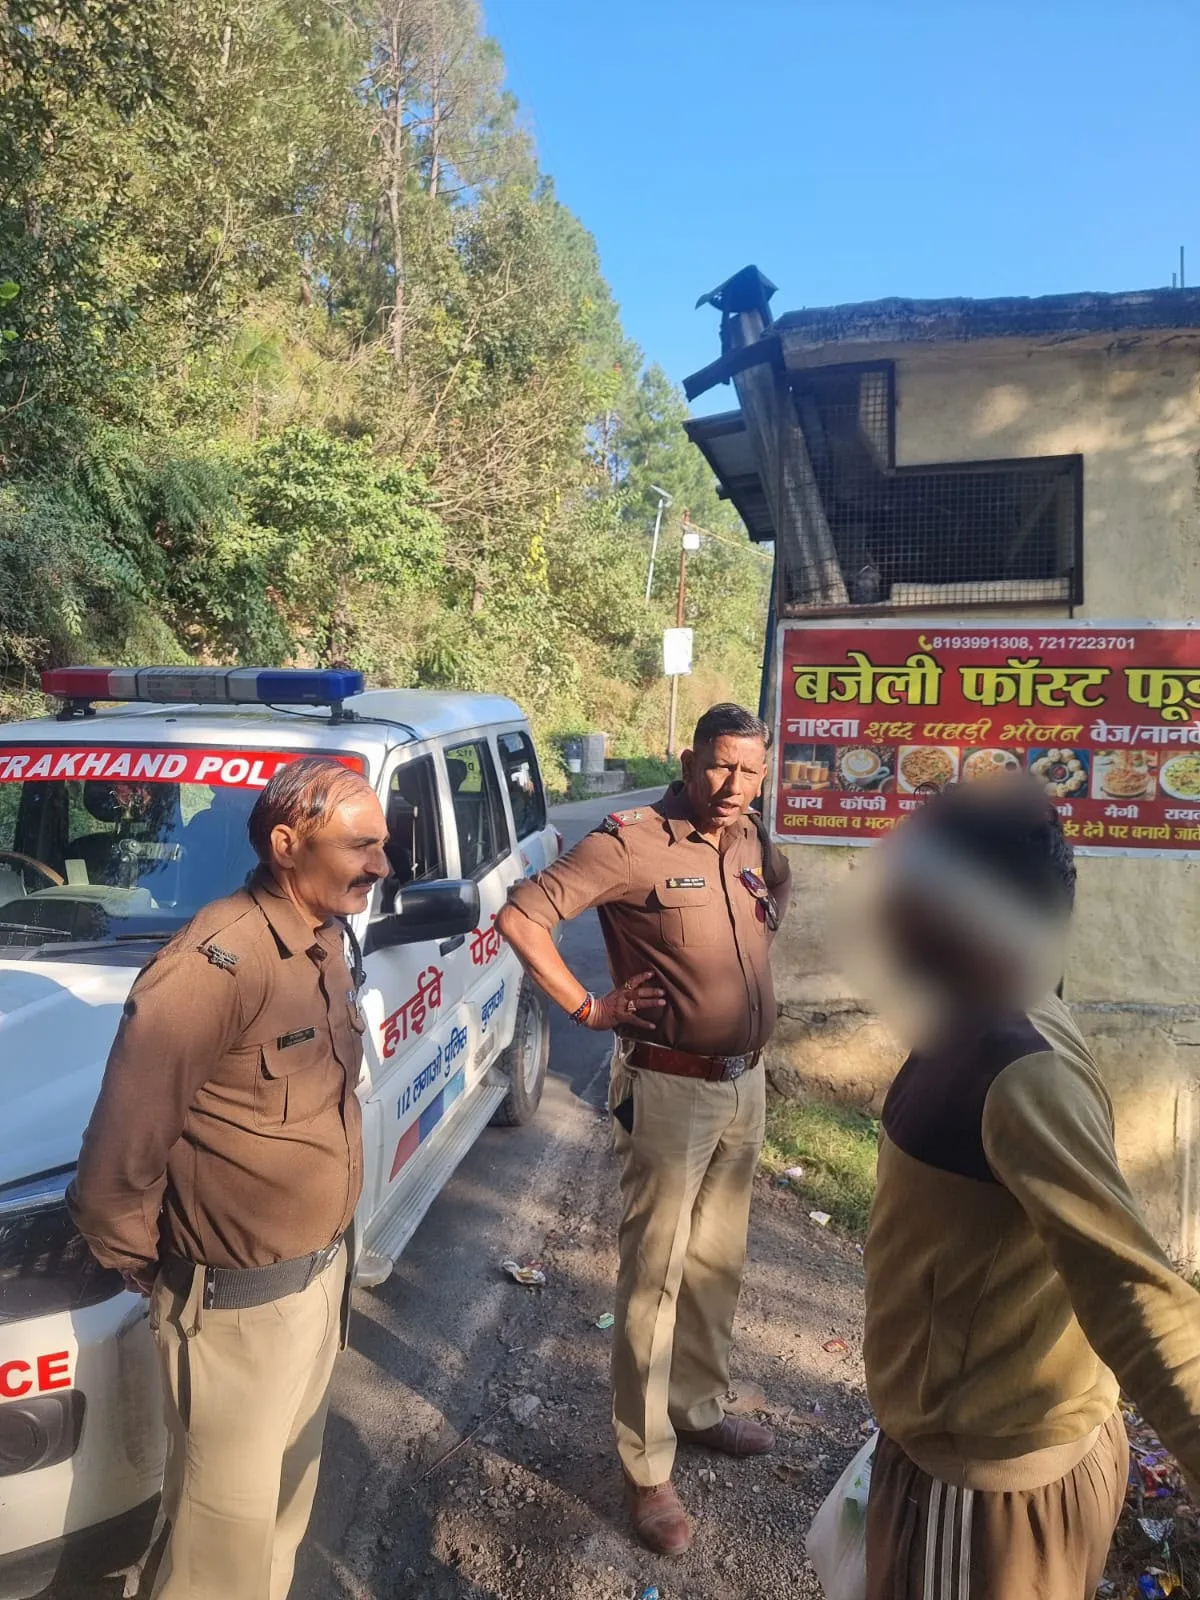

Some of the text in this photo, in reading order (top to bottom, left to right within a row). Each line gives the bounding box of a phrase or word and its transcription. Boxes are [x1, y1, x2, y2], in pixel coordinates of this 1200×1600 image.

[932, 636, 1136, 651] 8193991308, 7217223701
[791, 650, 944, 707] बजेली
[958, 657, 1112, 708] फॉस्ट
[787, 718, 860, 738] नाश्ता
[922, 717, 992, 745] पहाड़ी
[999, 718, 1084, 743] भोजन
[194, 755, 286, 787] POL
[786, 796, 824, 810] चाय
[840, 795, 887, 811] कॉफी
[1103, 804, 1139, 818] मैगी
[783, 813, 848, 829] दाल-चावल
[851, 817, 861, 829] व
[1083, 820, 1105, 838] देने
[1109, 825, 1129, 838] पर
[1131, 823, 1170, 840] बनाये
[379, 913, 502, 1059] हाईवे पेट्रो
[397, 978, 505, 1121] 112 लगाओ पुलिस बुलाओ
